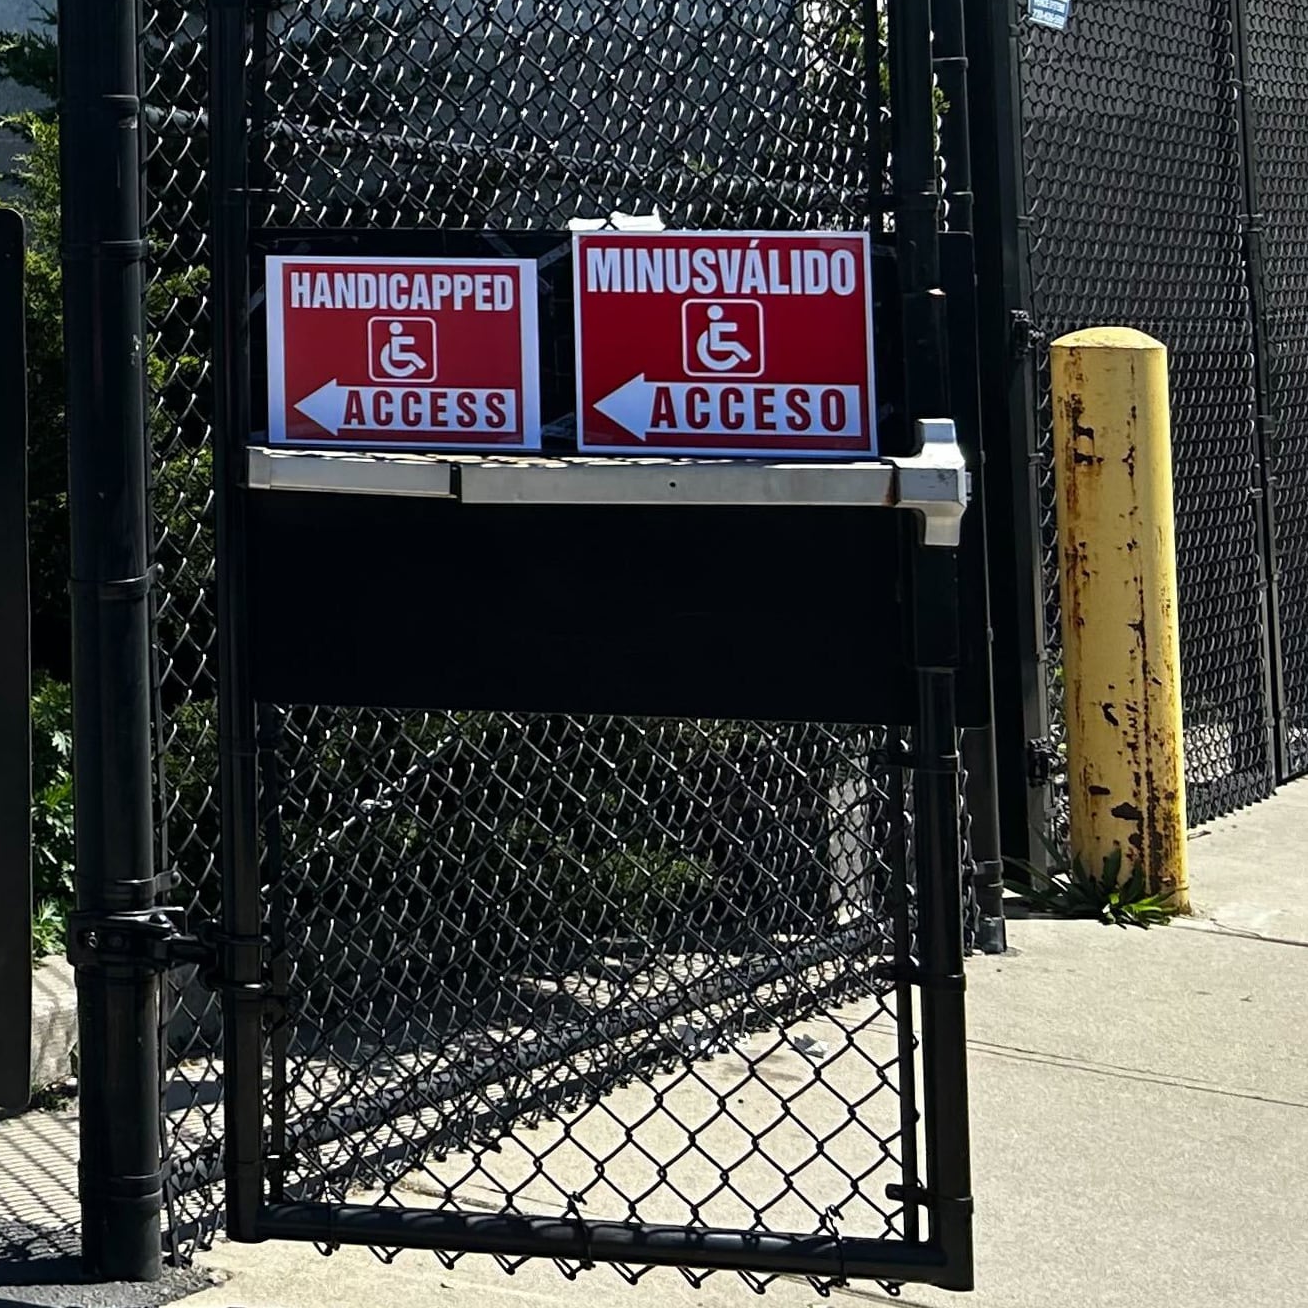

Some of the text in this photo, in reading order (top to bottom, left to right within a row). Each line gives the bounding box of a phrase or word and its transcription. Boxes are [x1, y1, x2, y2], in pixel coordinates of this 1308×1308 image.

[586, 240, 856, 296] MINUSVÁLIDO
[290, 271, 514, 312] HANDICAPPED
[342, 389, 508, 430] ACCESS
[649, 385, 848, 433] ACCESO
